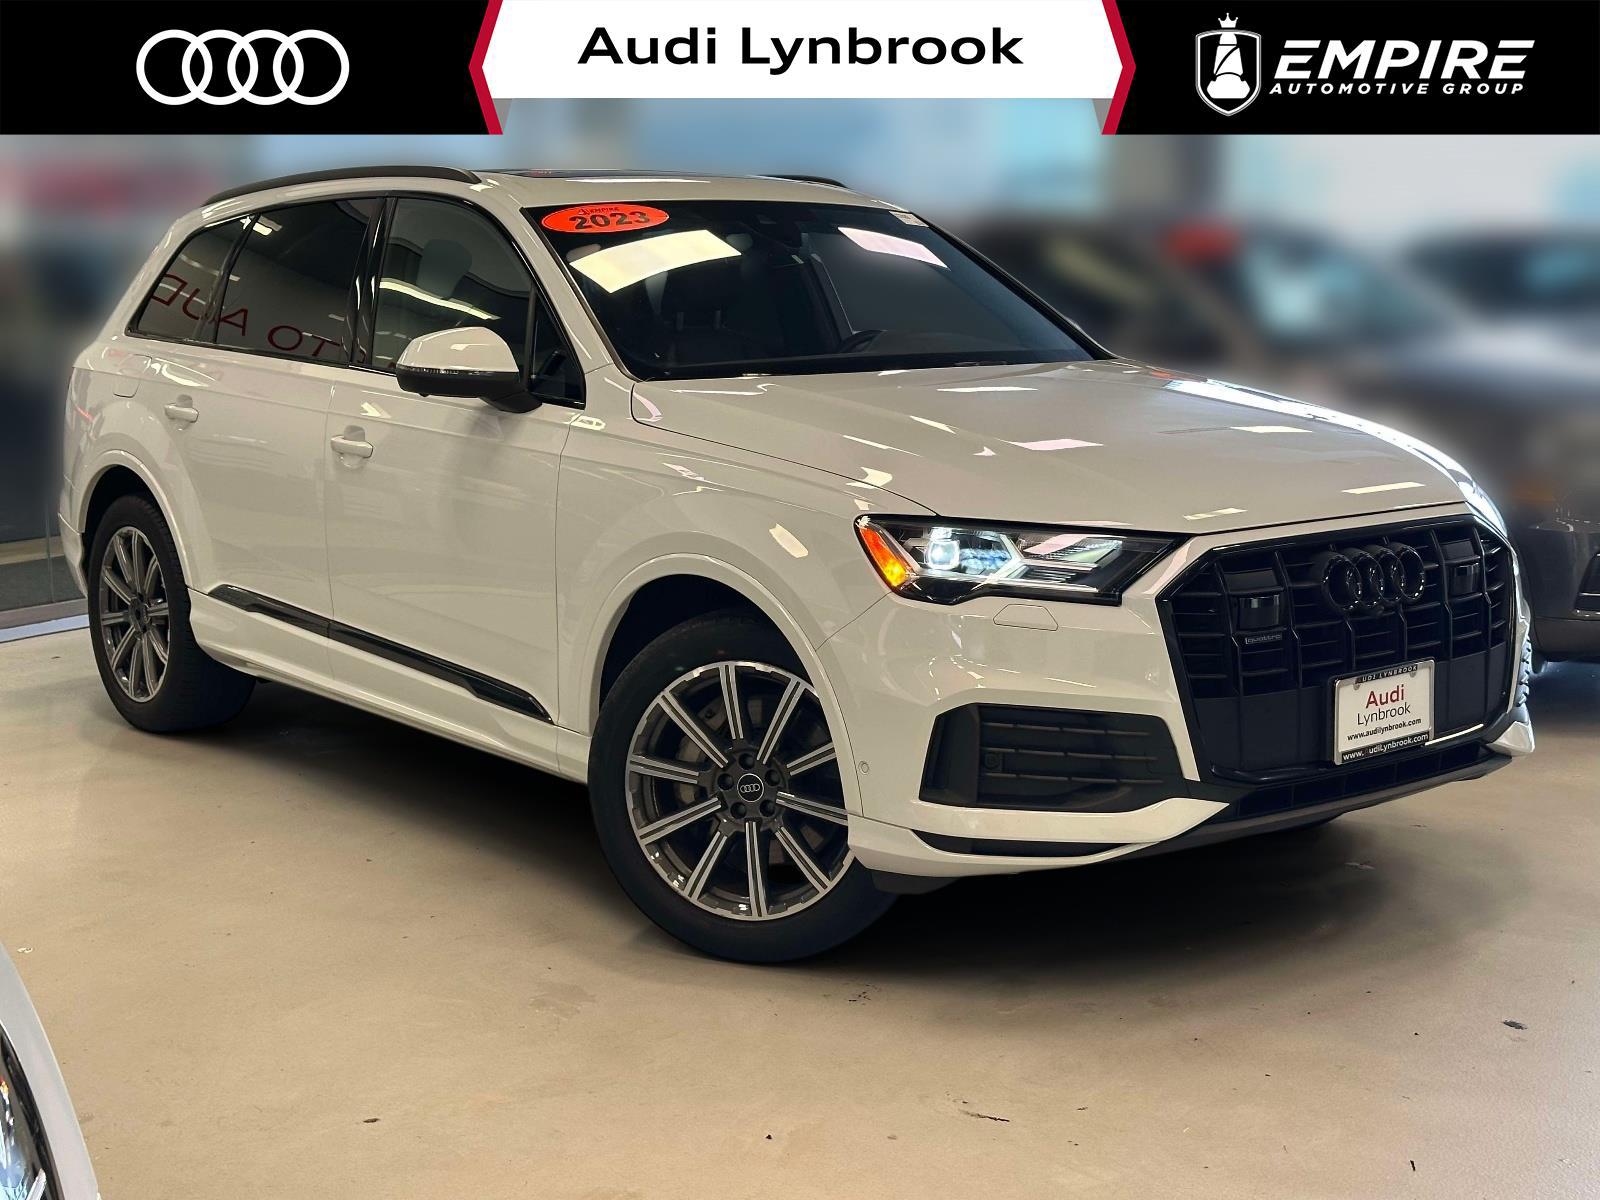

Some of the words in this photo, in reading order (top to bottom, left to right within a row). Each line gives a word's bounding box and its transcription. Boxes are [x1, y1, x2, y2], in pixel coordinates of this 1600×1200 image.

[569, 211, 650, 230] 2023
[1365, 684, 1405, 708] Audi
[1357, 702, 1411, 726] Lynbrook
[1343, 733, 1429, 761] www.udiLynbrook.com
